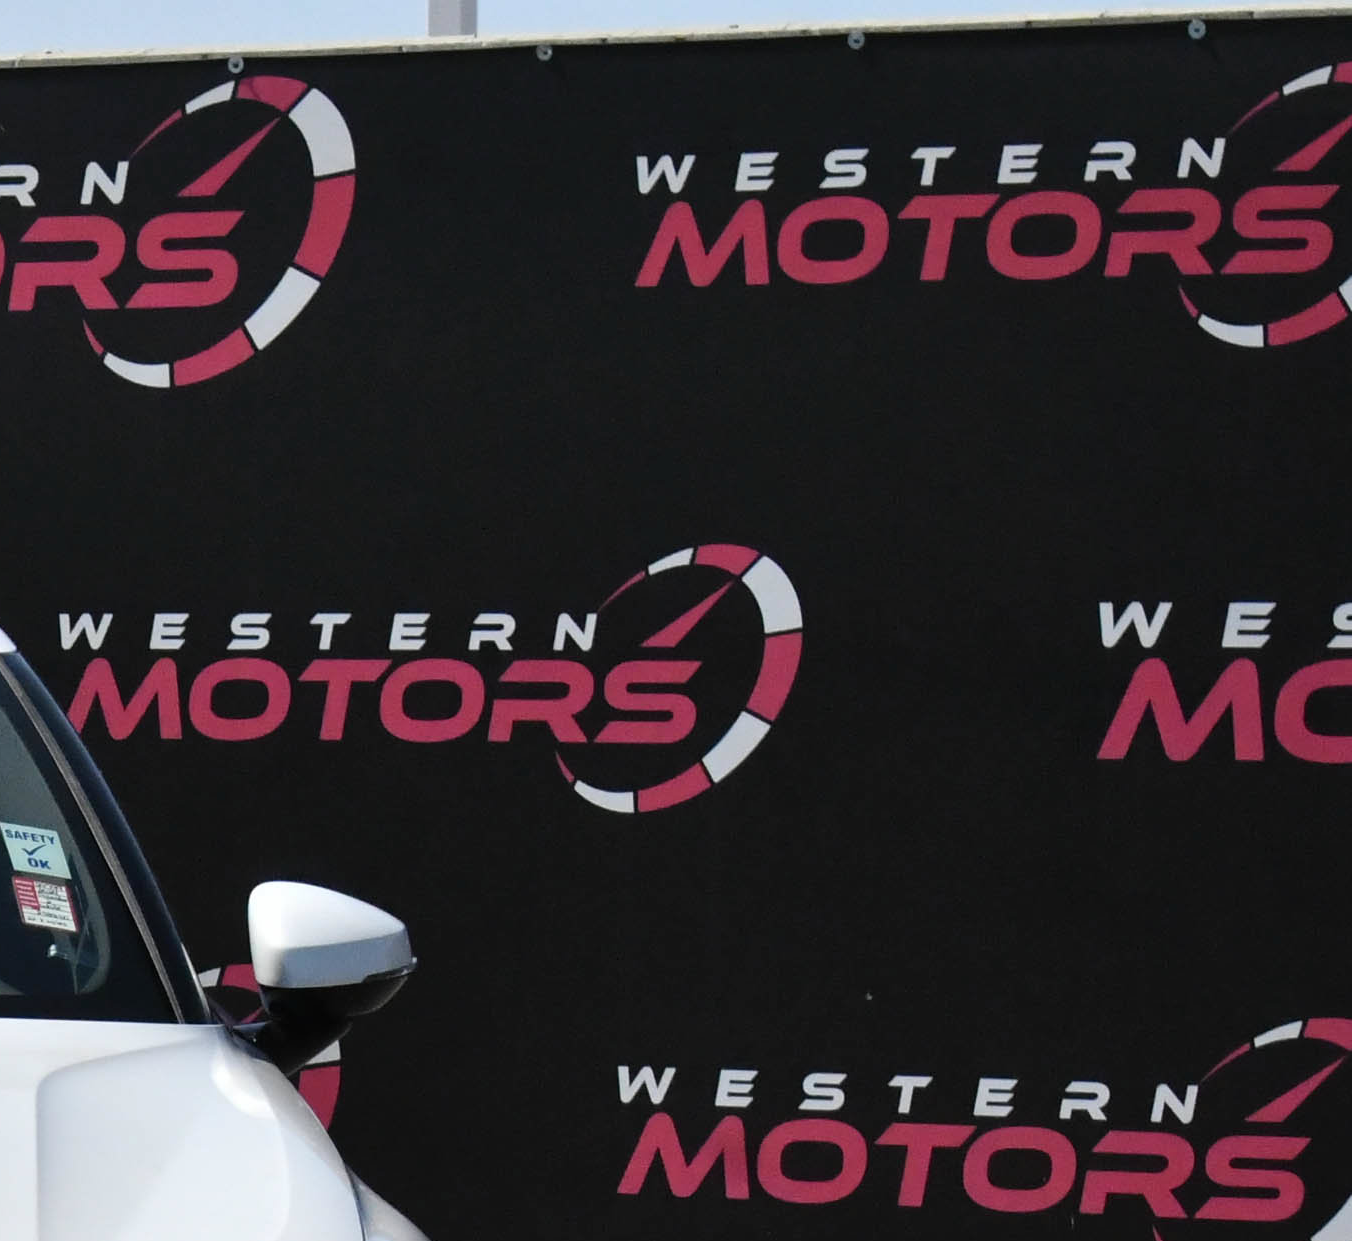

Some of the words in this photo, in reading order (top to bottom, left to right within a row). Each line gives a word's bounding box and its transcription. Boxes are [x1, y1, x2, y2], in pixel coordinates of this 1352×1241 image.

[637, 138, 1225, 194] WESTERN
[637, 185, 1339, 286] MOTORS
[60, 613, 597, 651] WESTERN
[69, 658, 700, 744] MOTORS
[5, 829, 55, 844] SAFETY
[28, 858, 51, 869] OK
[618, 1066, 1198, 1123] WESTERN
[619, 1112, 1309, 1221] MOTORS
